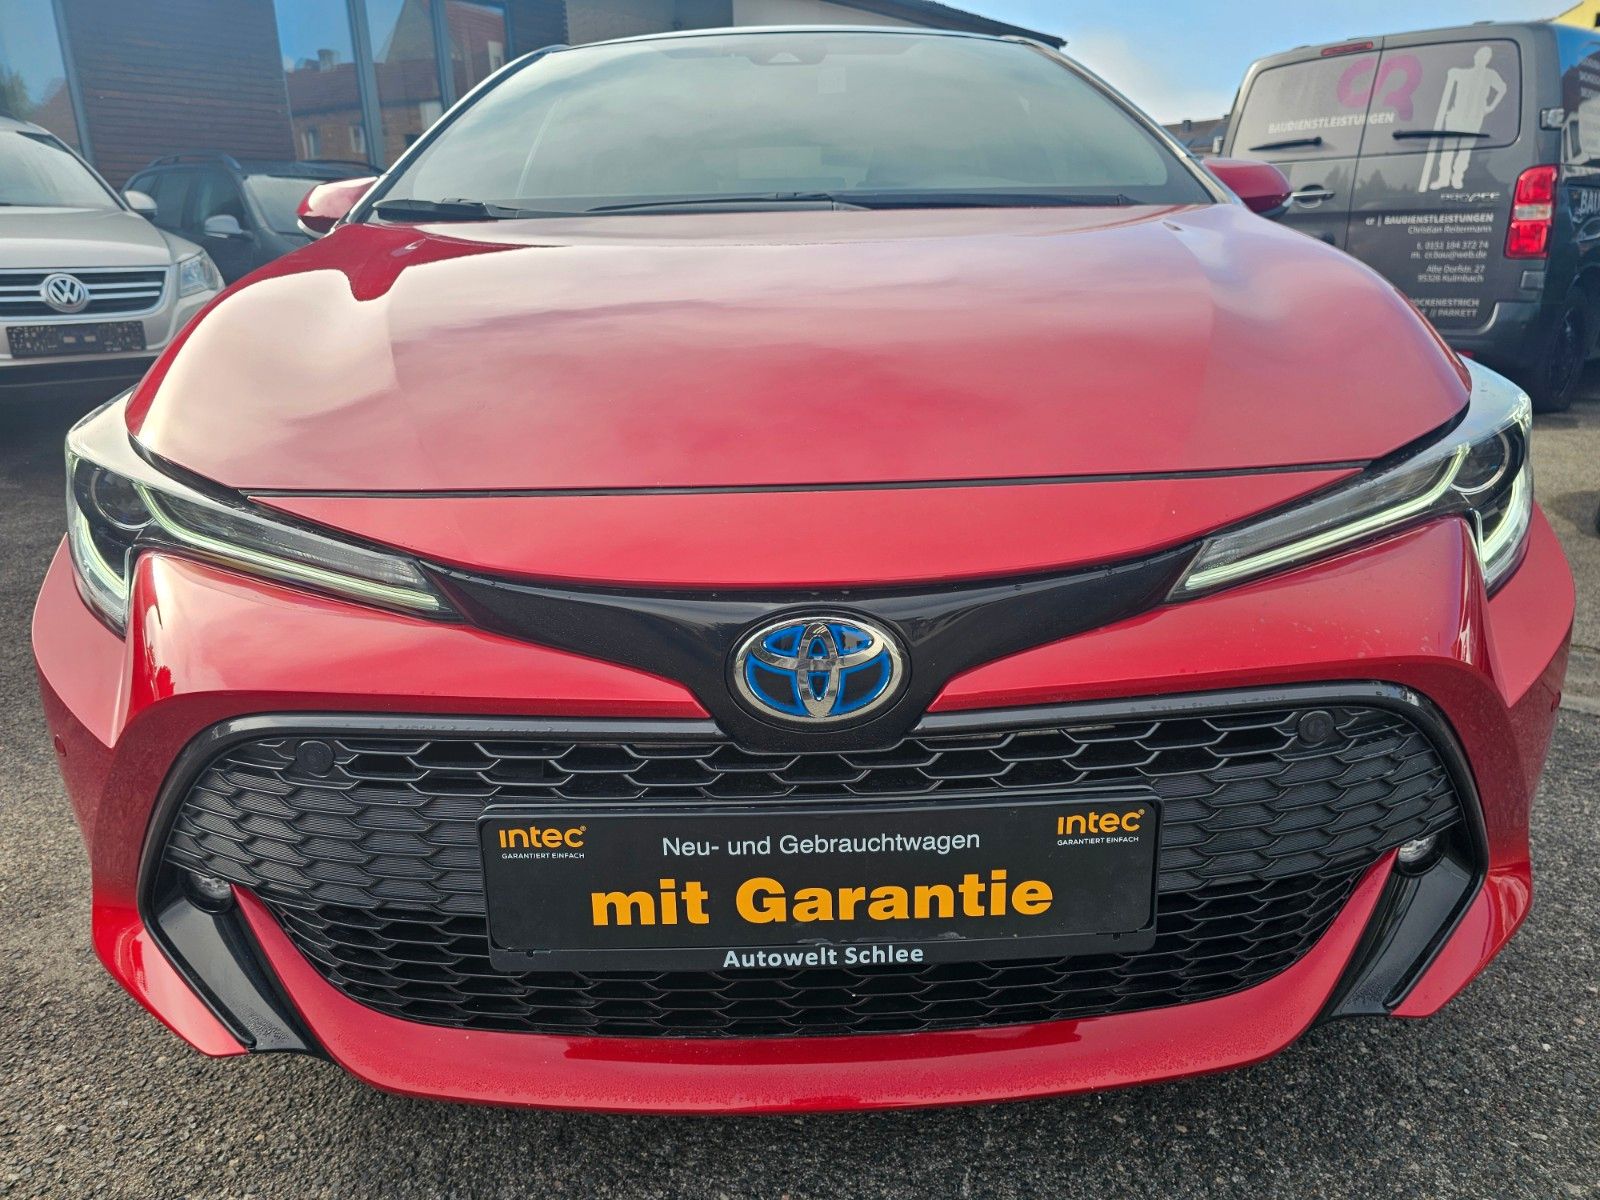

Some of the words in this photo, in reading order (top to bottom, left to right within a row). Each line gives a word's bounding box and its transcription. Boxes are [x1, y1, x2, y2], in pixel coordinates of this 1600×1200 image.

[1268, 112, 1395, 134] BAUDIENSTLEISTUNGEN
[1384, 213, 1494, 225] BAUDIENSTLEISTUNGEN
[1407, 226, 1441, 235] Christian
[1442, 274, 1484, 283] Kulmbach
[1437, 308, 1478, 318] PARKETT
[662, 836, 719, 856] Neu-
[727, 835, 771, 855] und
[779, 832, 981, 855] Gebrauchtwagen
[1057, 838, 1105, 846] GARANTIERT
[1106, 836, 1140, 844] EINFACH
[591, 878, 709, 926] mit
[735, 869, 1054, 924] Garantie
[722, 947, 838, 968] Autowelt
[844, 945, 925, 965] Schlee
